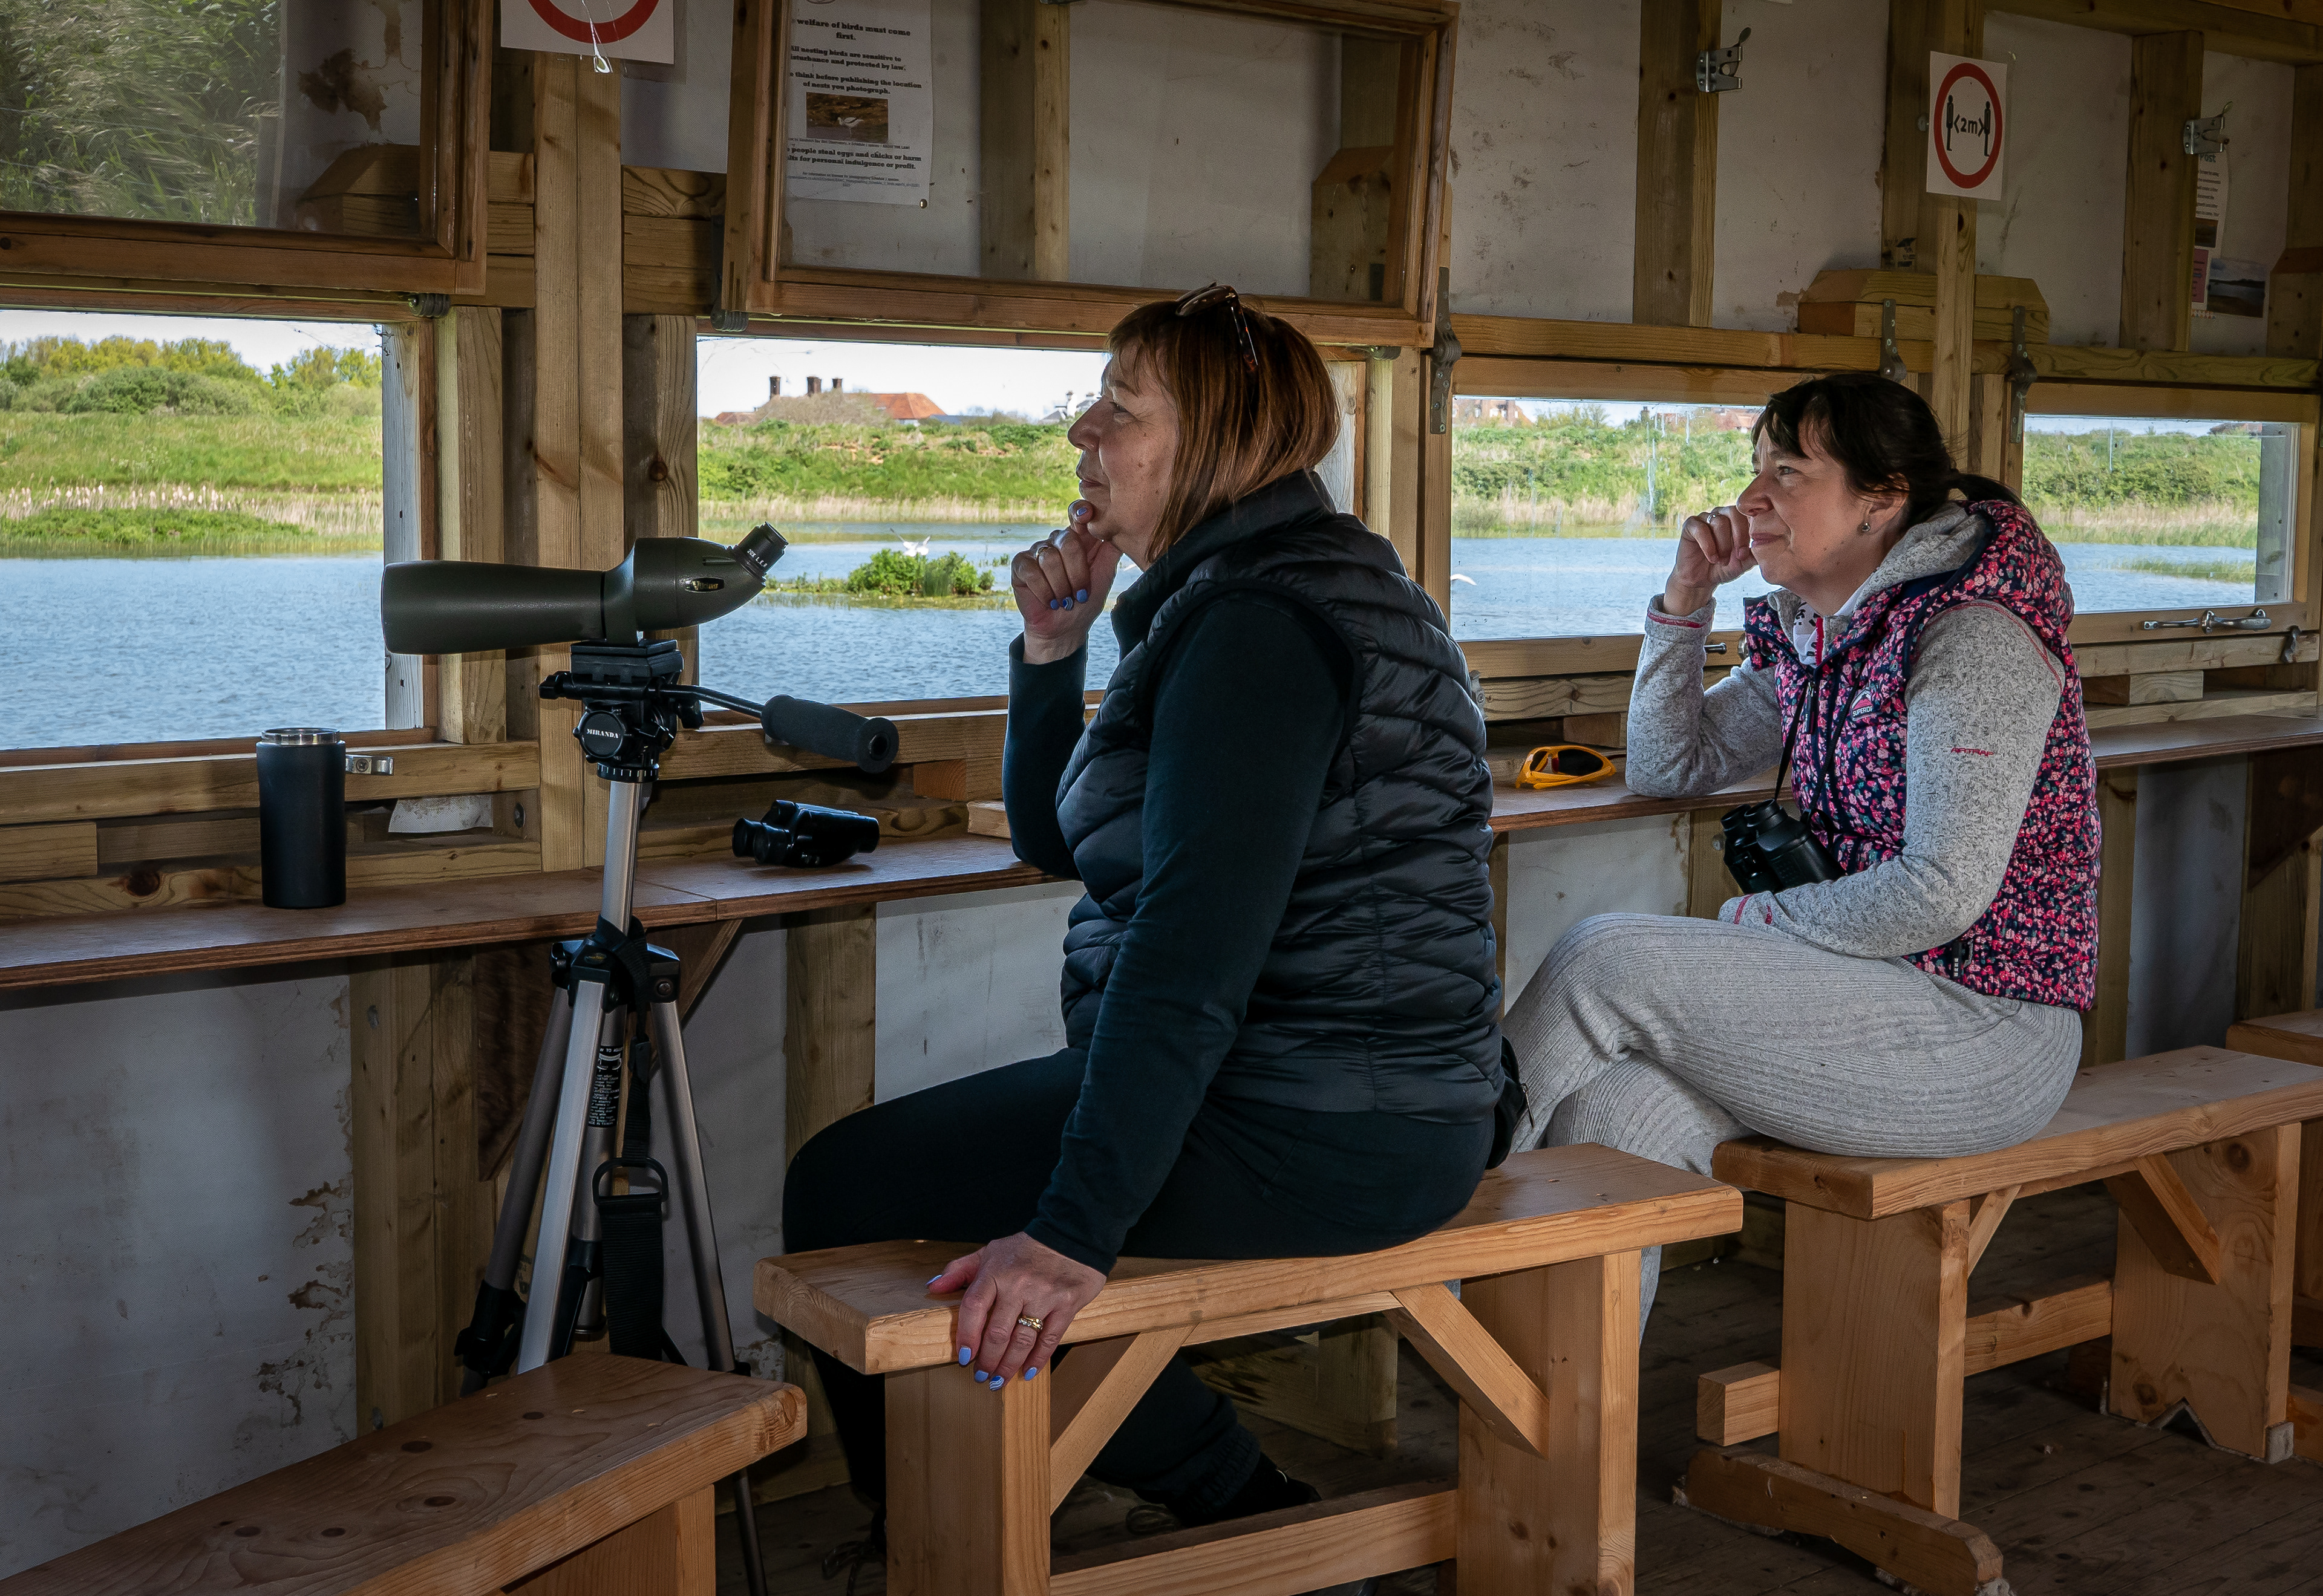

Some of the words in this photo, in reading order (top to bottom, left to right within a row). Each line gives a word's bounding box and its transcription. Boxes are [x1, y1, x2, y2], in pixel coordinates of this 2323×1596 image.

[797, 19, 829, 27] welfare
[800, 47, 828, 56] nesting
[862, 53, 893, 61] sensitive
[790, 54, 829, 63] isturbance
[846, 60, 880, 69] protected
[840, 76, 878, 86] publishing
[892, 80, 922, 89] location
[846, 85, 890, 95] photograph.
[845, 158, 884, 168] indulgence
[747, 549, 756, 558] 20X
[586, 728, 618, 738] MIRANDA
